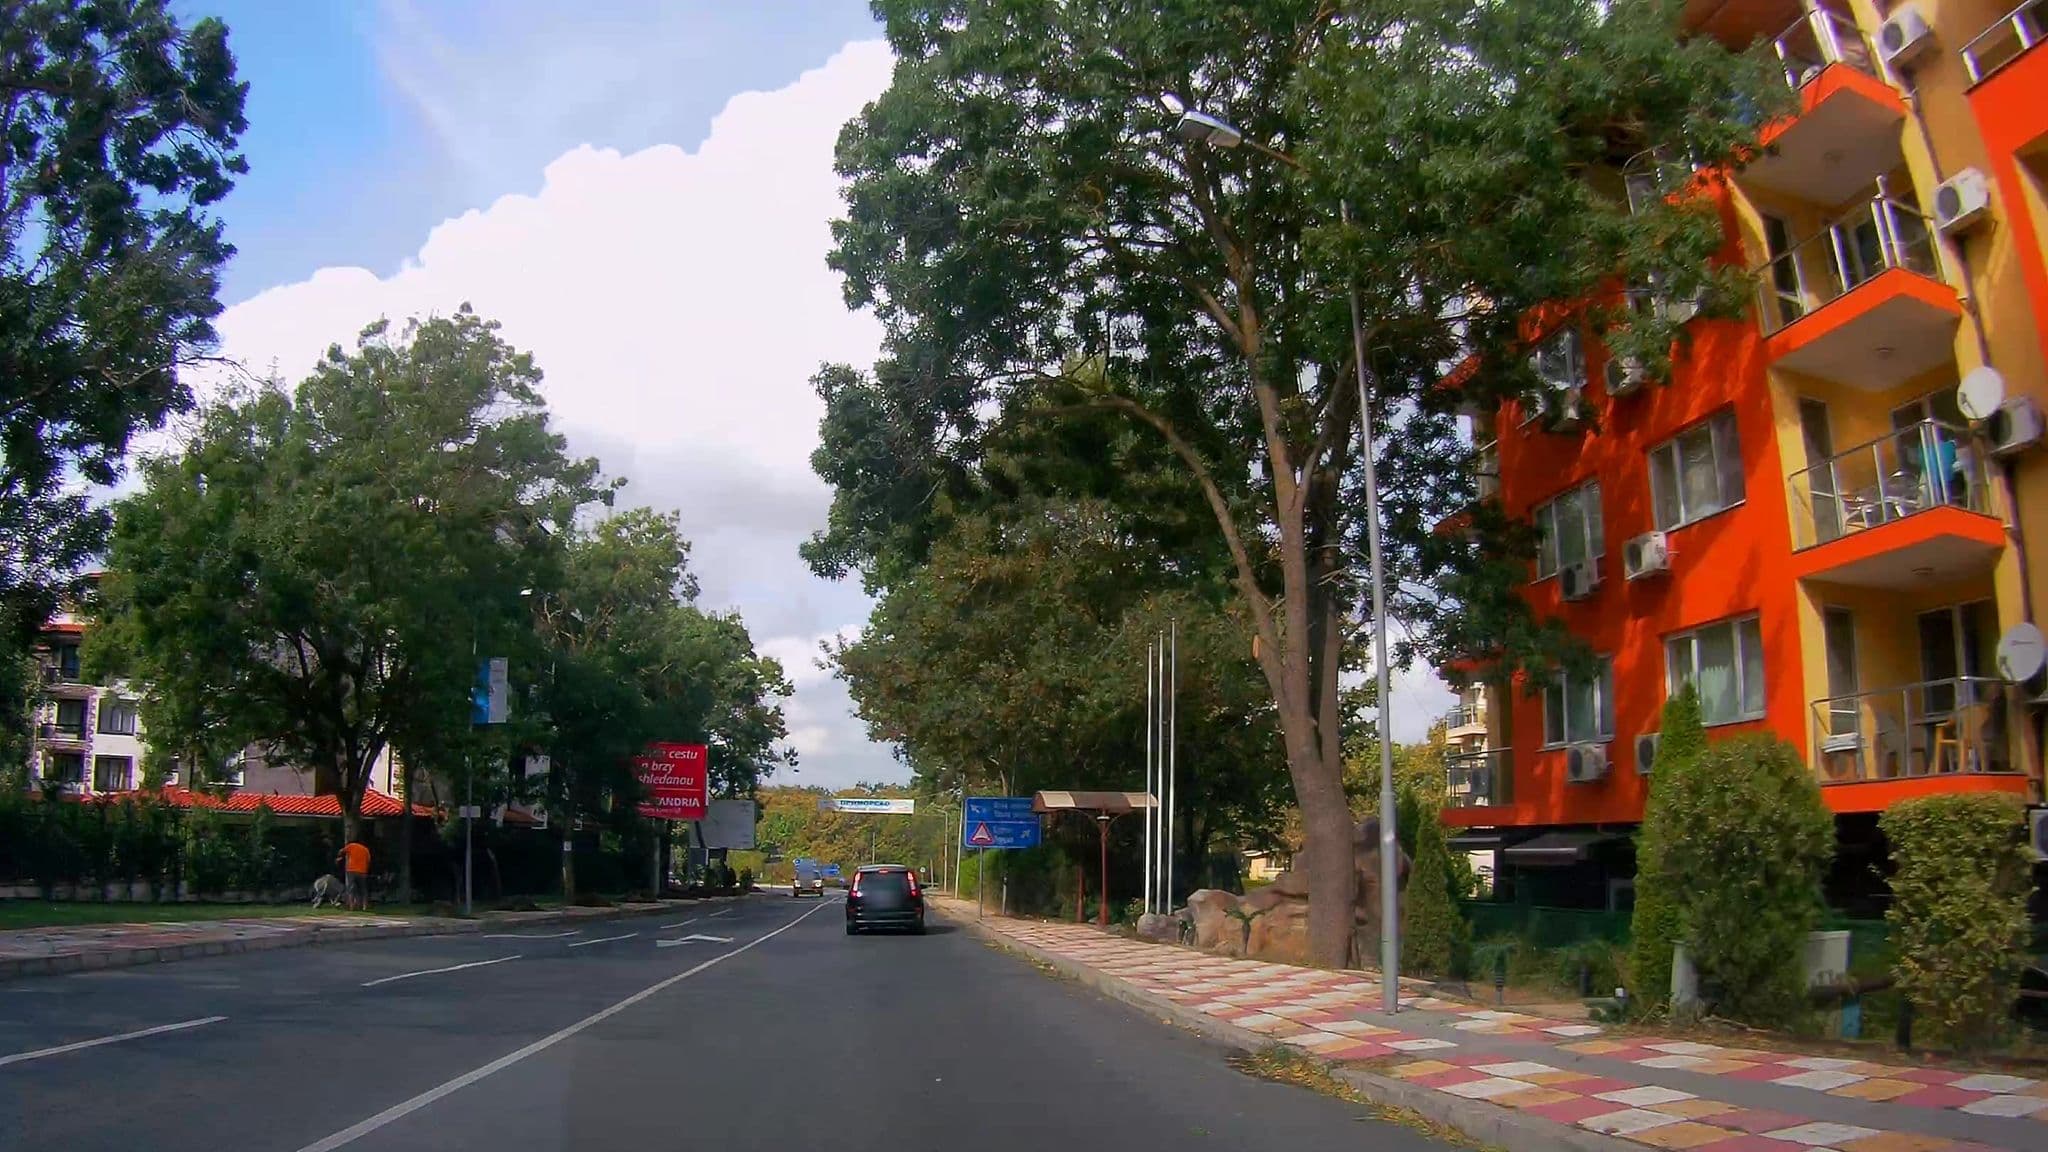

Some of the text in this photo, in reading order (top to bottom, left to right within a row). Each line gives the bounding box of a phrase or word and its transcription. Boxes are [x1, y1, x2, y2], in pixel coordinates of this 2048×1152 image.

[668, 750, 698, 760] cestu
[651, 760, 675, 775] brzy
[657, 797, 700, 807] ANDRIA
